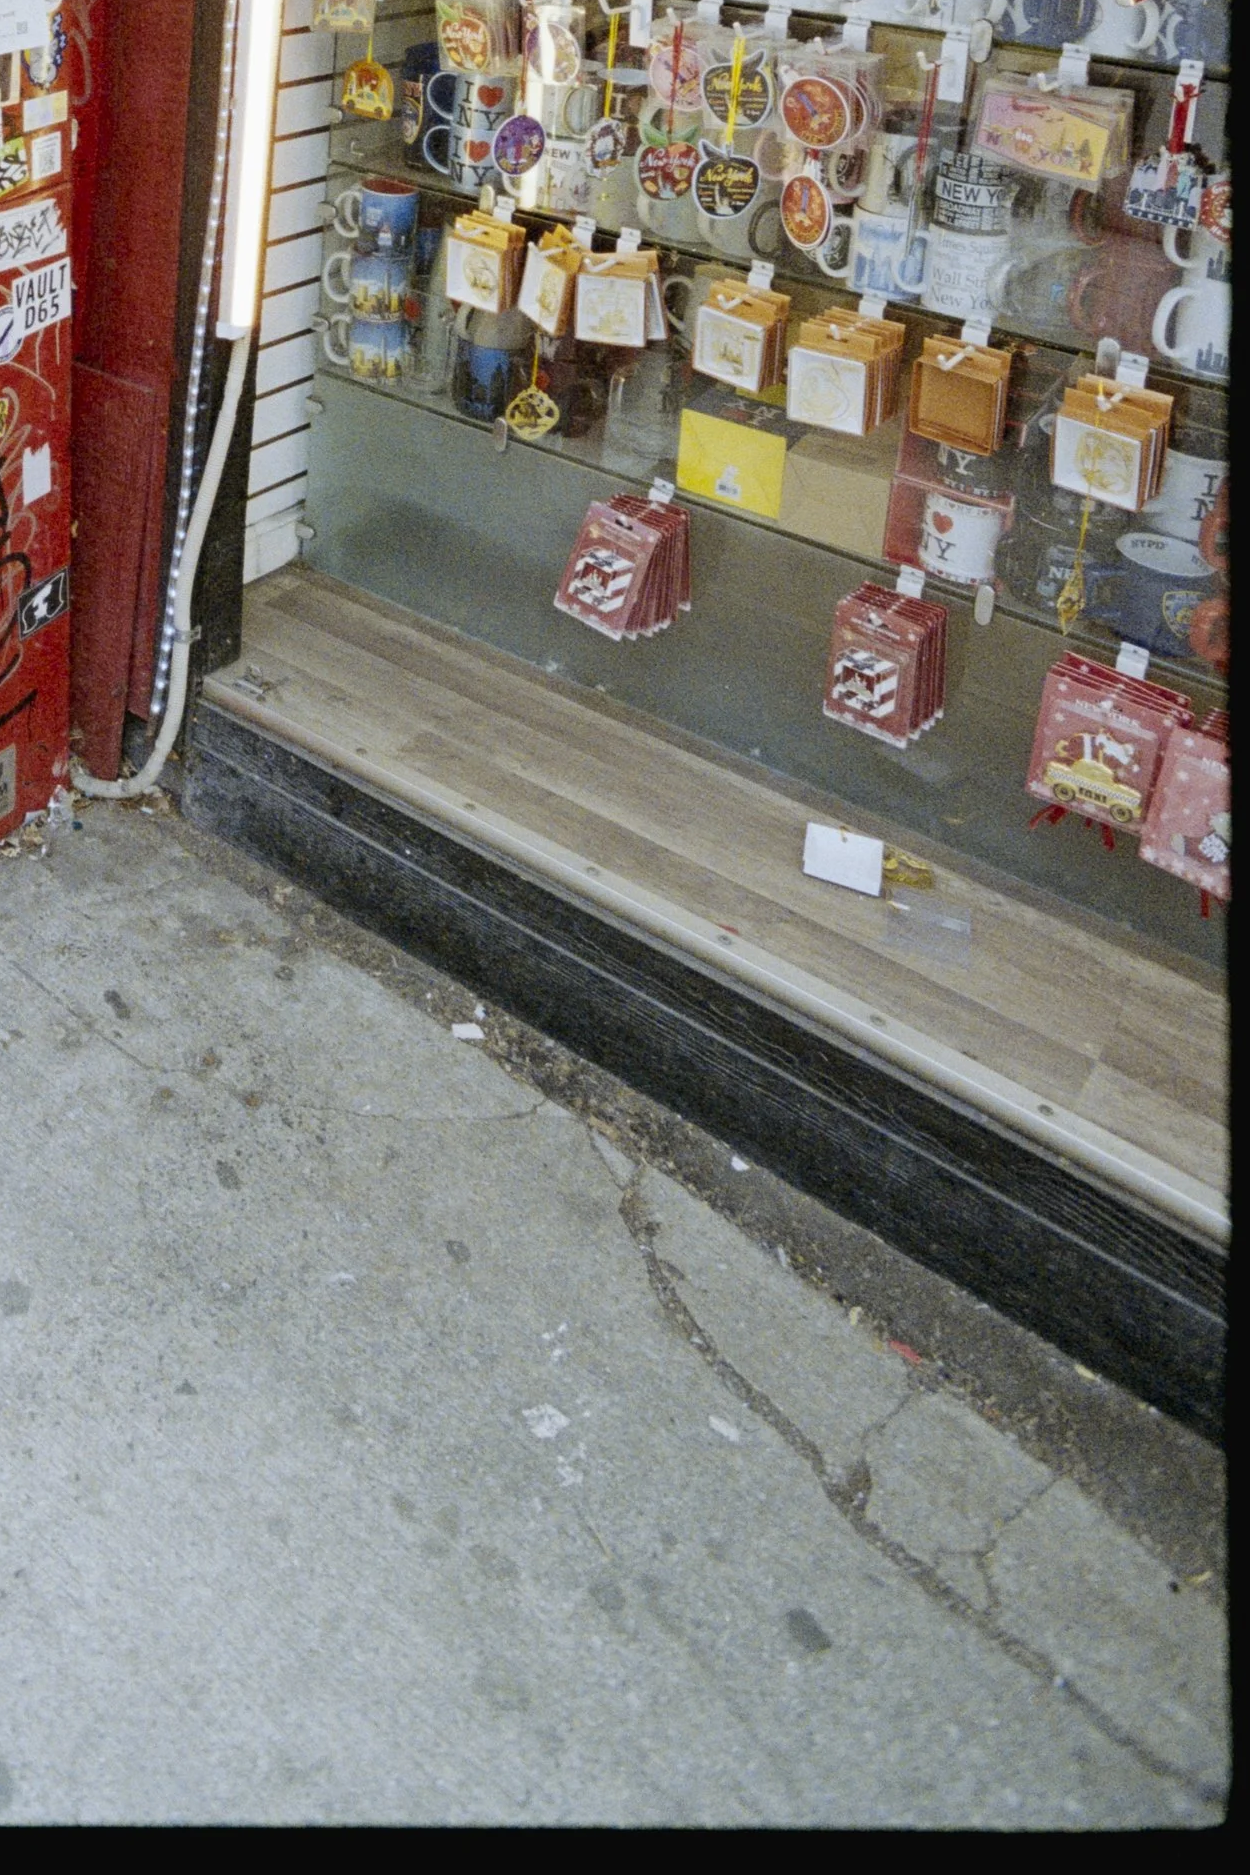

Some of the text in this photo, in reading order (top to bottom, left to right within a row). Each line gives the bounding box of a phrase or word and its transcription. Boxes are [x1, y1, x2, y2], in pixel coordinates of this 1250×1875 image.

[463, 80, 475, 104] I
[457, 104, 506, 131] NY
[453, 135, 463, 159] I
[450, 161, 495, 187] NY
[941, 180, 981, 203] NEW
[16, 263, 68, 309] VAULT
[932, 265, 961, 286] Wall
[930, 287, 963, 307] New
[25, 294, 60, 329] D65
